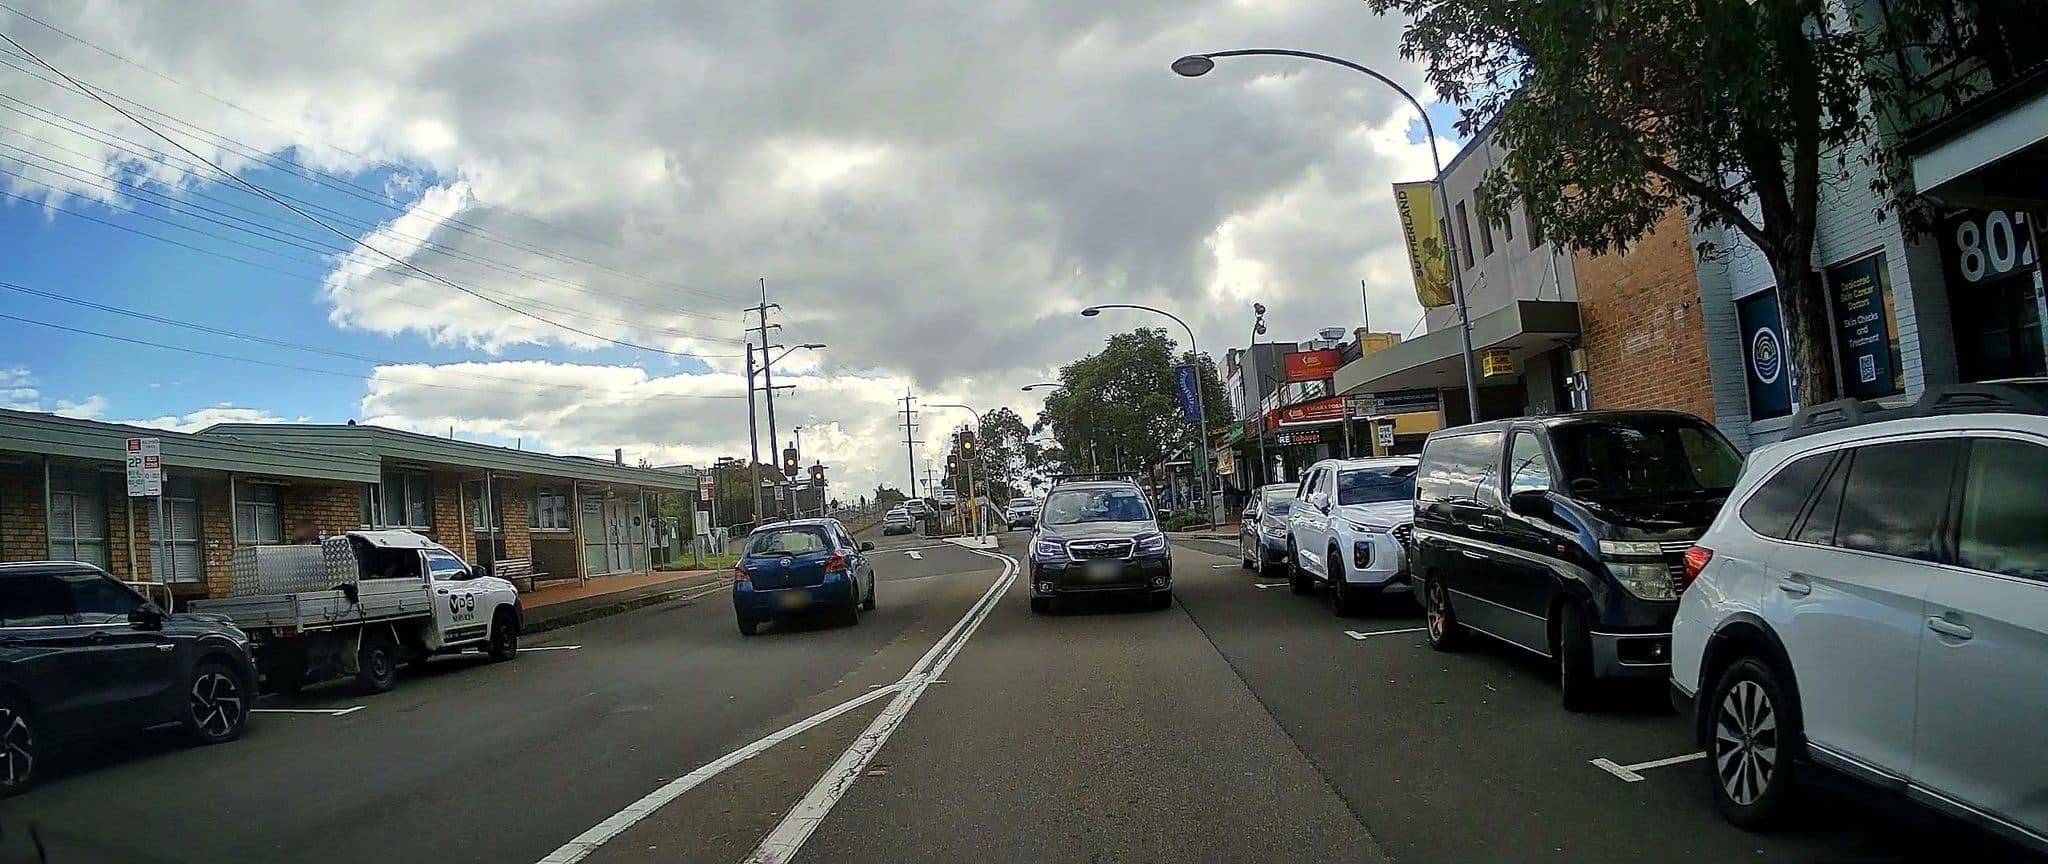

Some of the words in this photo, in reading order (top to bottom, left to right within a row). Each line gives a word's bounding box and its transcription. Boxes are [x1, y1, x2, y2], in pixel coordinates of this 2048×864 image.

[1398, 190, 1424, 278] SUTHERLAND
[1840, 292, 1854, 302] Skin
[1854, 285, 1874, 298] Cancer
[1848, 299, 1869, 311] Doctors
[1843, 317, 1857, 328] Skin
[1857, 312, 1879, 325] Checks
[1856, 325, 1869, 336] and
[1849, 334, 1879, 348] Treatment
[128, 458, 142, 468] 2P
